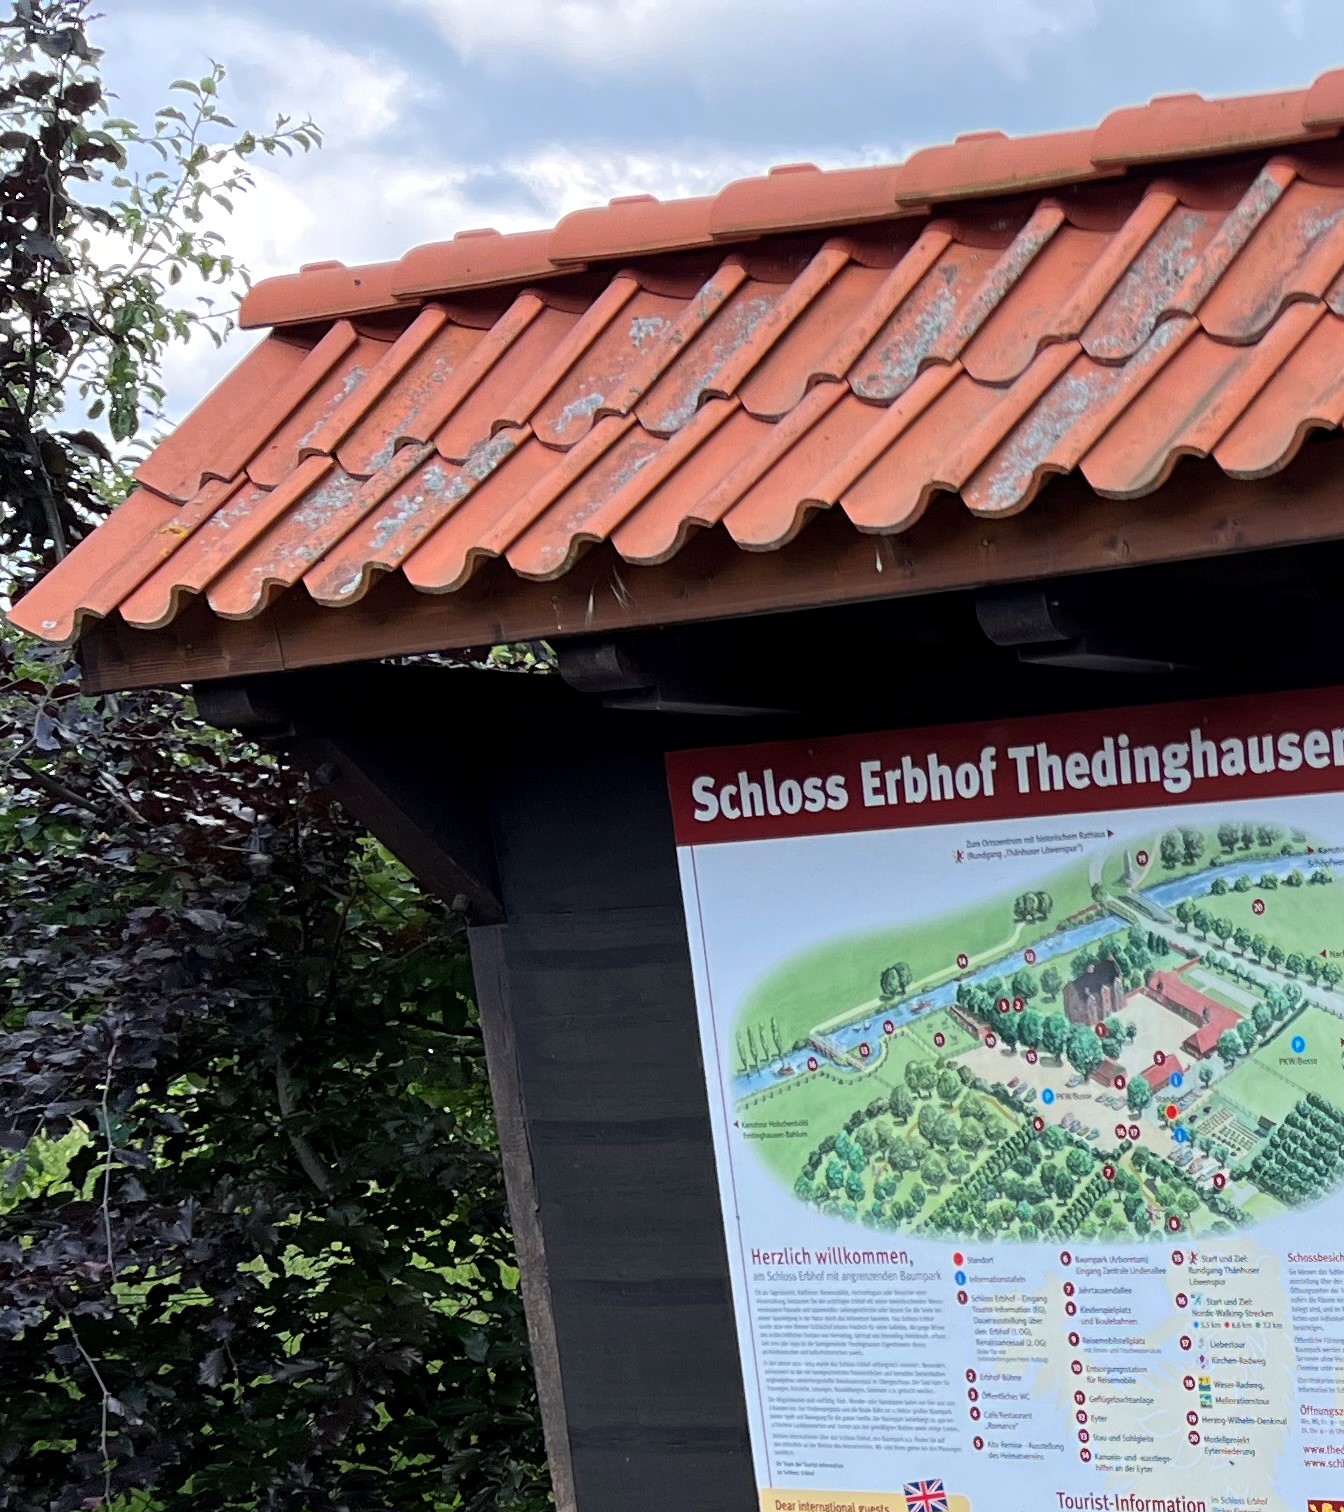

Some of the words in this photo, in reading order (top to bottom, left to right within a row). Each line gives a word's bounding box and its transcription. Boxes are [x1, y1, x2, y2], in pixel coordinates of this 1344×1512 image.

[692, 769, 848, 821] Schloss
[862, 746, 996, 806] Erbhof
[1117, 1078, 1123, 1086] 4
[1171, 1219, 1177, 1227] 8
[750, 1247, 811, 1265] Herzlich
[814, 1246, 914, 1267] willkommen,
[766, 1270, 797, 1281] Schloss
[798, 1270, 825, 1281] Erbhof
[826, 1270, 839, 1281] mit
[840, 1270, 898, 1282] angrenzenden
[899, 1270, 942, 1282] Baumpark
[1075, 1267, 1101, 1276] Eingang
[1188, 1267, 1223, 1276] Rundgang
[1090, 1415, 1107, 1423] Eyter
[774, 1499, 795, 1511] Dear
[1220, 1496, 1244, 1504] Schloss
[1246, 1497, 1268, 1505] Erbhof
